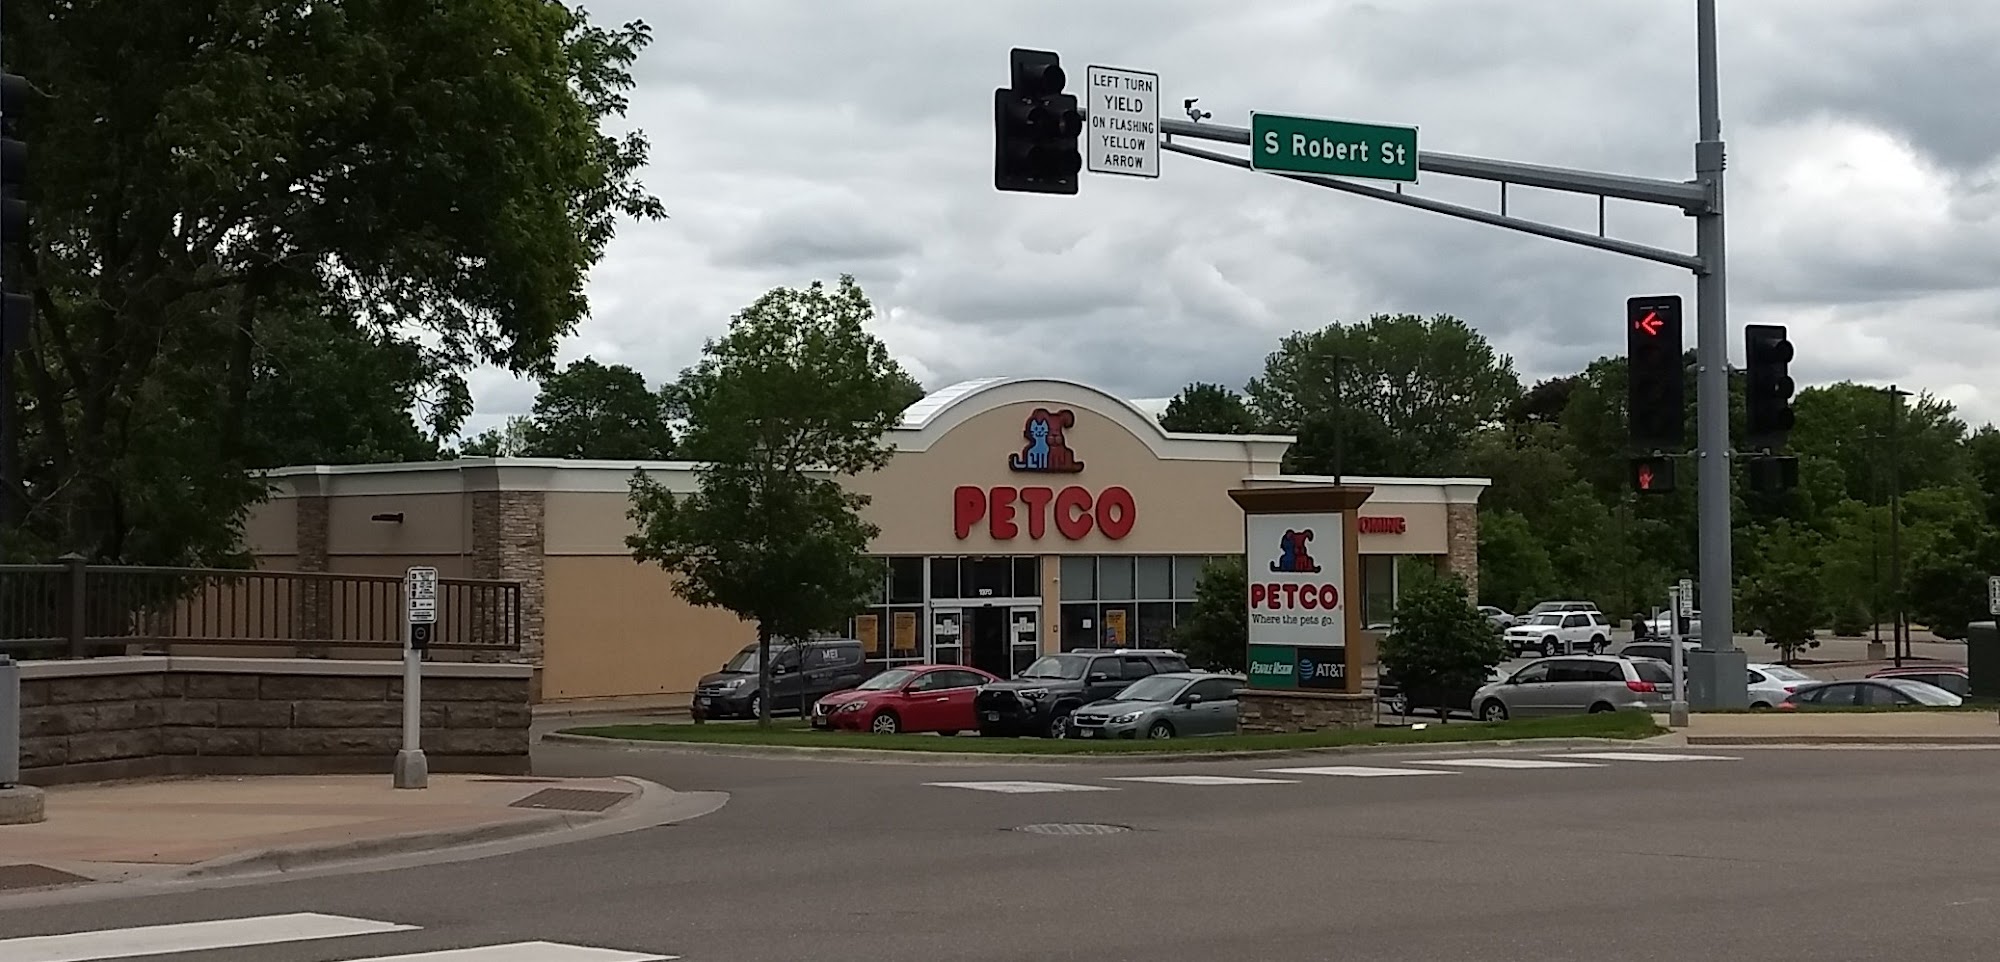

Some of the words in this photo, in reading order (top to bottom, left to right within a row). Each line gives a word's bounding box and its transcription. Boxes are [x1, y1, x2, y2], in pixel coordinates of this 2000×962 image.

[1094, 74, 1119, 88] LEFT
[1125, 78, 1152, 92] TURN
[1104, 95, 1143, 112] YIELD
[1093, 116, 1105, 128] ON
[1110, 118, 1154, 133] FLASHING
[1102, 135, 1145, 150] YELLOW
[1264, 132, 1279, 154] S
[1292, 134, 1369, 162] Robert
[1381, 142, 1406, 165] St
[1104, 154, 1143, 168] ARROW
[954, 486, 1136, 540] PETCO
[1251, 584, 1338, 610] PETCO
[1252, 614, 1280, 624] Where
[1283, 615, 1298, 624] the
[1300, 616, 1319, 626] pets
[1315, 663, 1345, 677] AT&T
